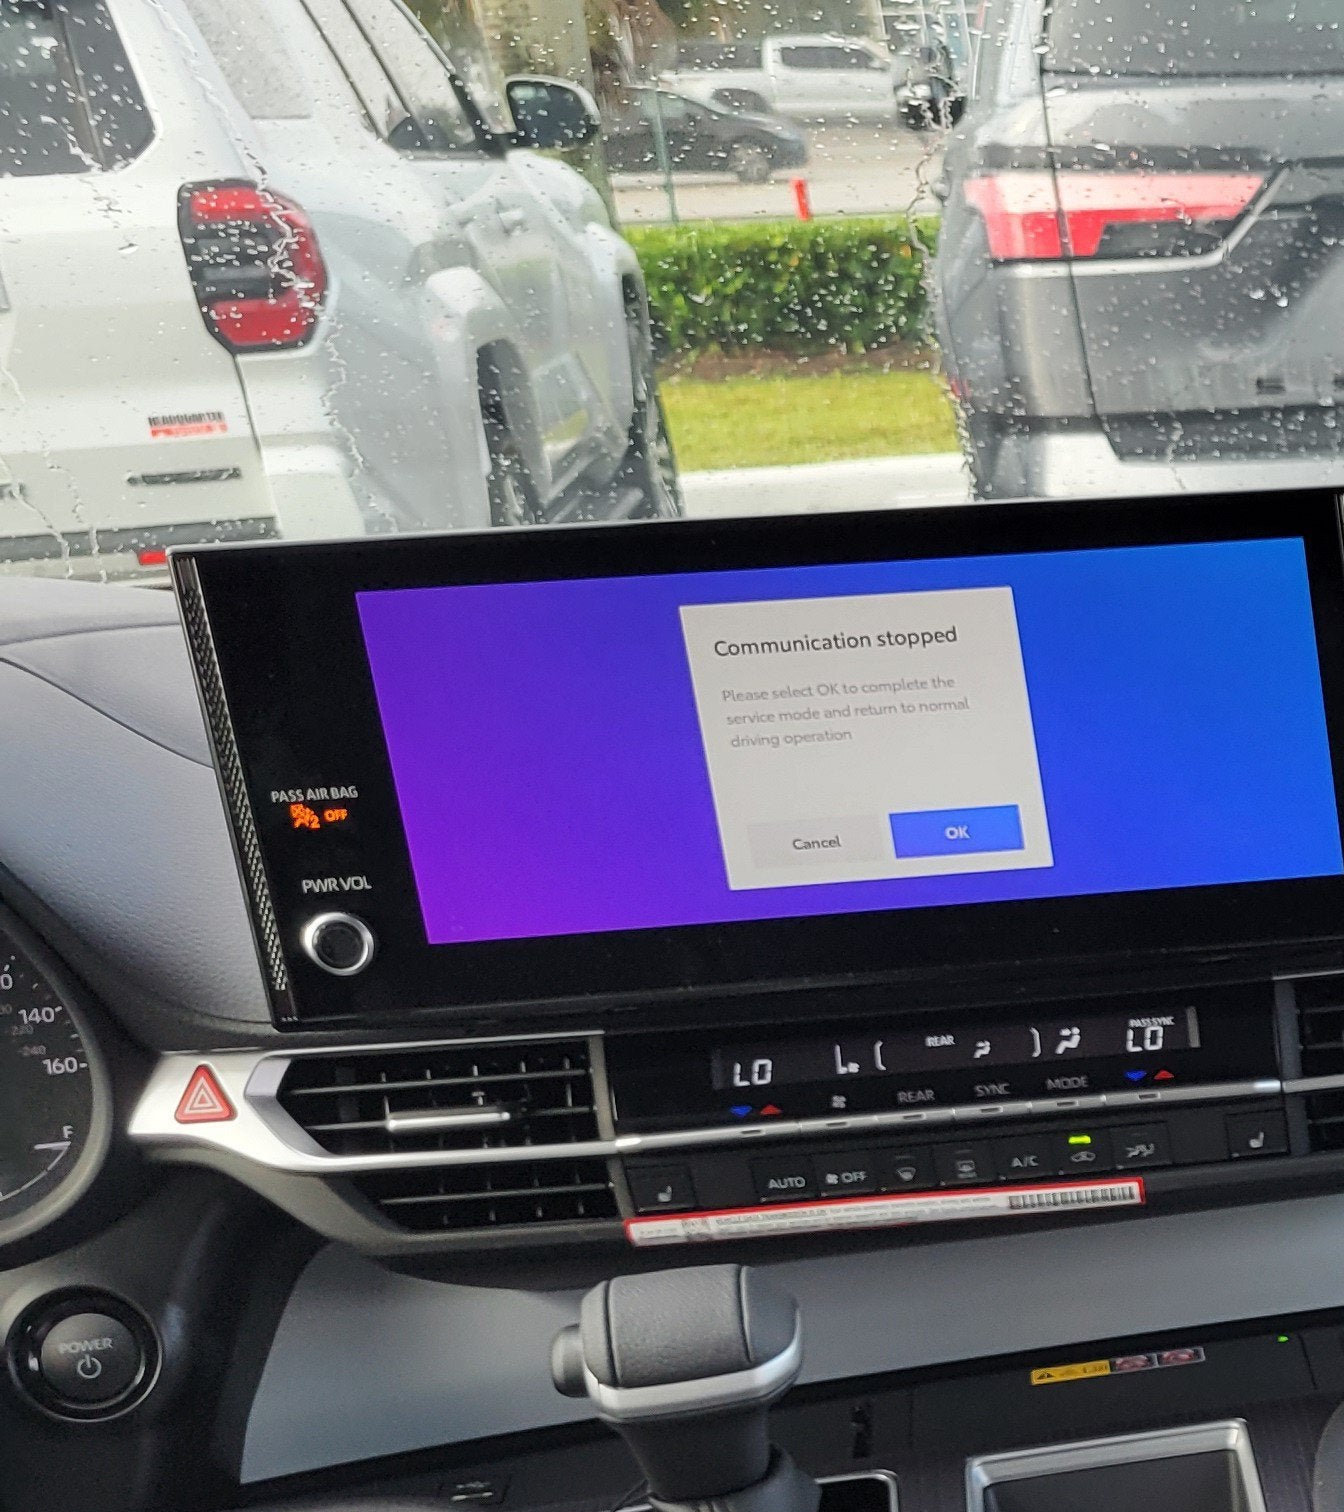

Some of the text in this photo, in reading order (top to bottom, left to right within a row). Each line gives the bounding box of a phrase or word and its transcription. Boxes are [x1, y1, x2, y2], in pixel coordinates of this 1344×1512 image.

[714, 625, 958, 657] Communication stopped
[723, 675, 956, 702] Please select OK to complete the
[726, 697, 970, 726] service mode and return to normal
[731, 729, 853, 749] driving operation
[271, 785, 359, 803] PASS AIR BAG
[323, 808, 348, 822] OFF
[945, 825, 971, 840] OK
[792, 836, 842, 851] Cancel
[301, 875, 373, 894] PWR VOL
[18, 1006, 55, 1024] 140
[924, 1034, 956, 1047] REAR
[42, 1056, 79, 1075] 160
[974, 1082, 1011, 1097] SYNC
[1046, 1075, 1090, 1090] MODE
[897, 1089, 936, 1104] REAR
[62, 1125, 74, 1139] F
[1010, 1155, 1040, 1169] A/C
[768, 1176, 807, 1190] AUTO
[841, 1171, 868, 1183] OFF
[59, 1337, 113, 1354] POWER
